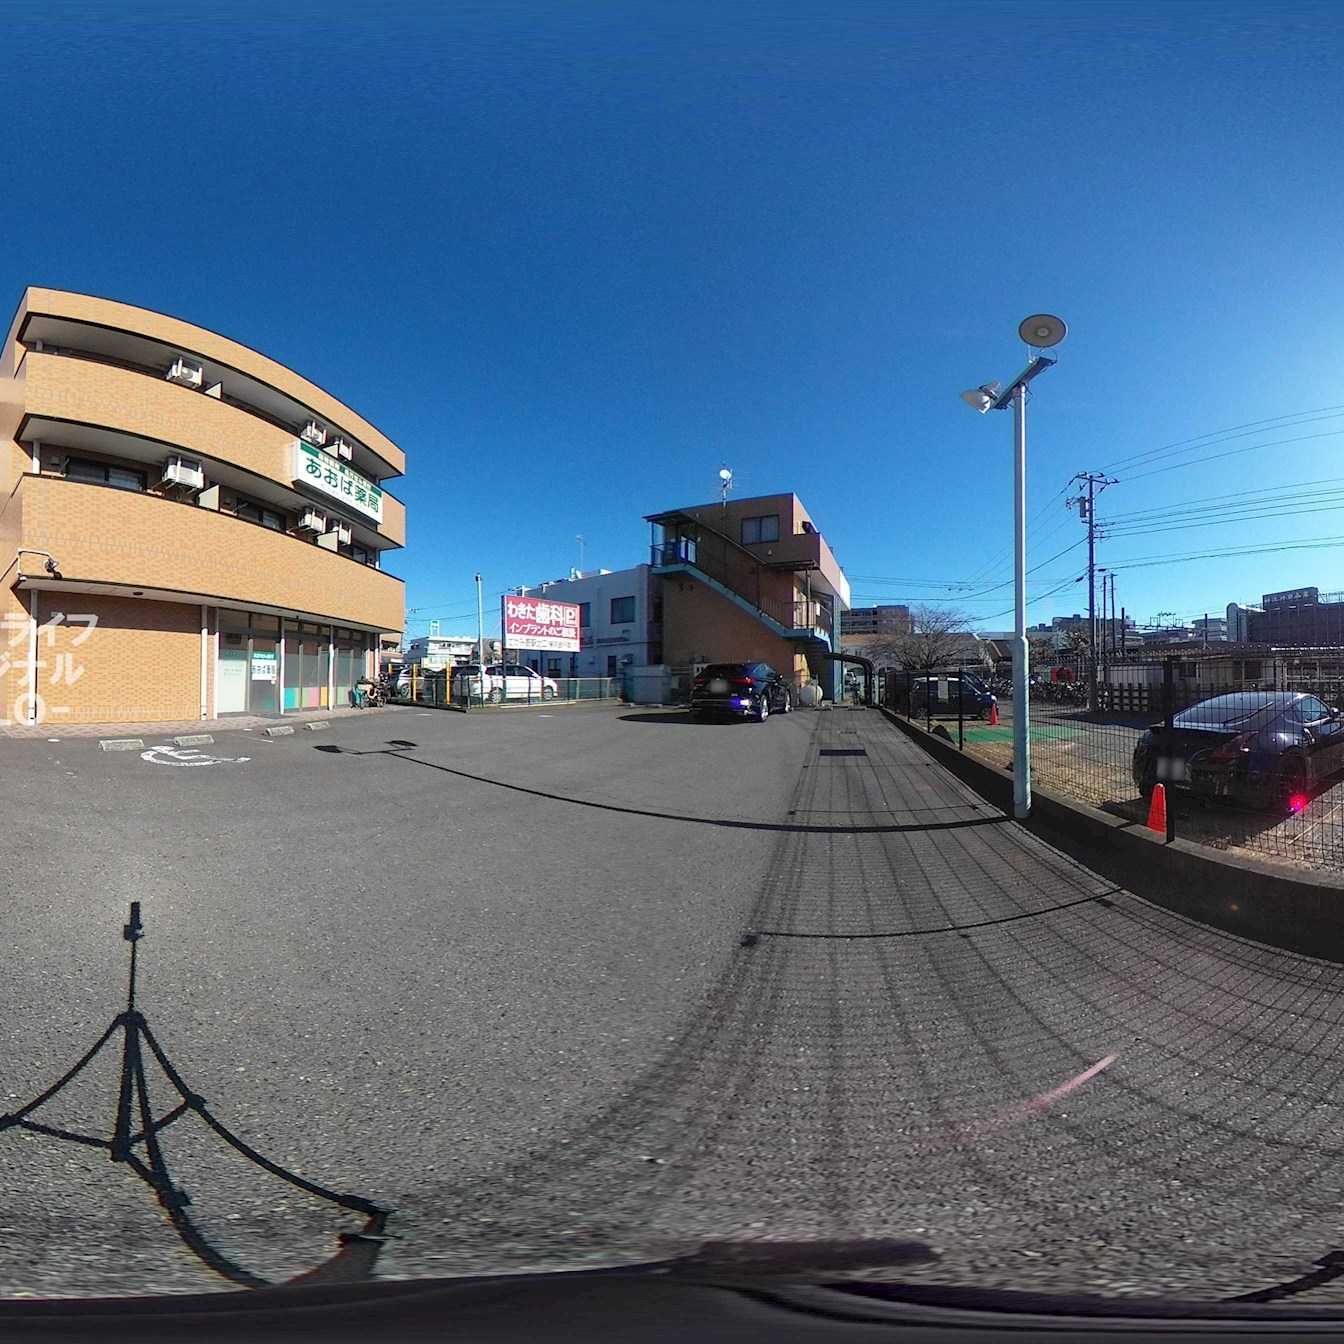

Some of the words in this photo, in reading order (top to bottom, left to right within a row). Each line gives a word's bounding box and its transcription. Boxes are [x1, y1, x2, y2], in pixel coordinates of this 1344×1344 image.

[305, 456, 379, 513] あおば薬局
[508, 602, 563, 626] わきた歯科
